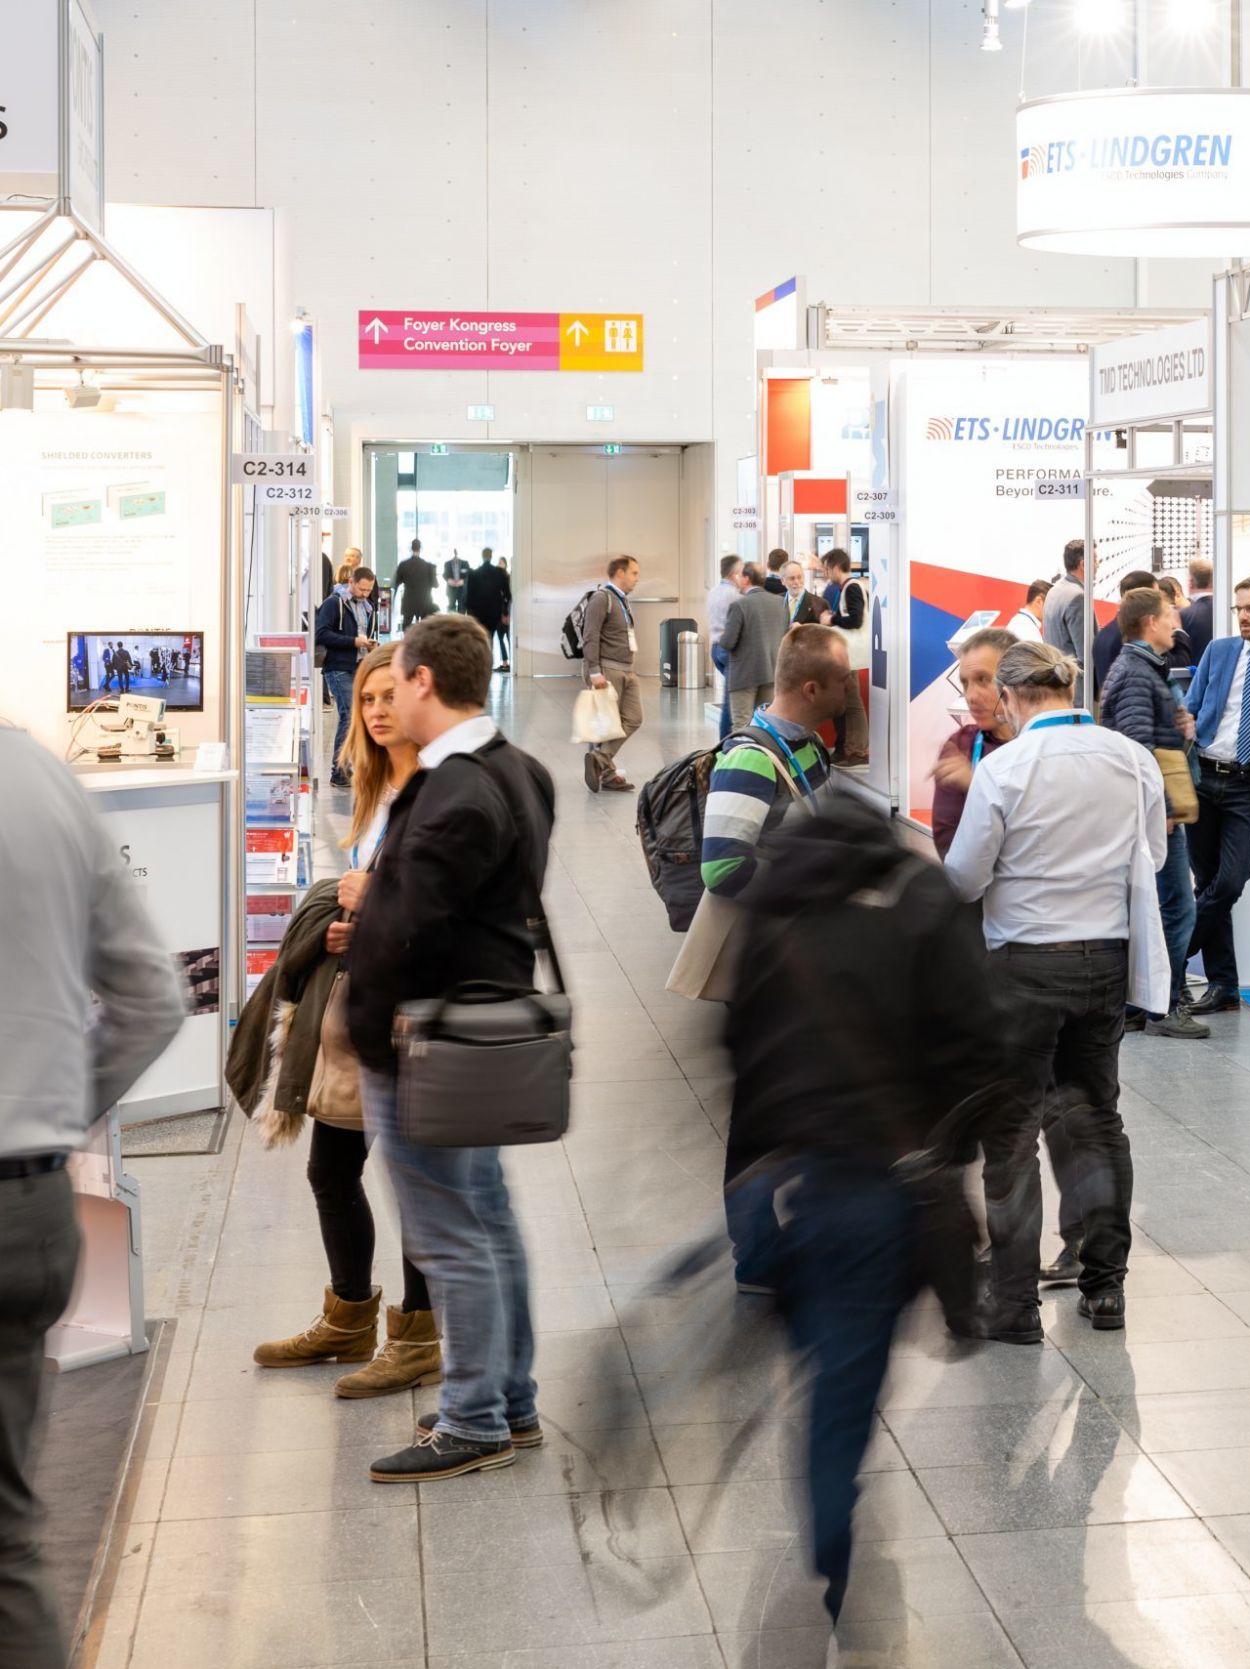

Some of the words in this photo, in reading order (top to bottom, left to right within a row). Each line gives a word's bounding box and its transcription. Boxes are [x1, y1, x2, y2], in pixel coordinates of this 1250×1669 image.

[404, 318, 447, 334] Foyer
[450, 318, 516, 334] Kongress
[404, 338, 486, 352] Convention
[491, 339, 532, 355] Foyer
[1117, 351, 1185, 392] TECHNOLOGIES
[1187, 347, 1205, 379] LTD
[41, 451, 88, 460] SHIELDED
[90, 451, 153, 460] CONVERTERS
[243, 461, 307, 476] C2-314
[995, 469, 1112, 480] PERFORMA
[266, 487, 312, 499] C2-312
[1038, 484, 1079, 495] C2-311
[856, 492, 888, 501] C2-307
[294, 506, 320, 515] 2-310
[864, 511, 896, 520] C2-309
